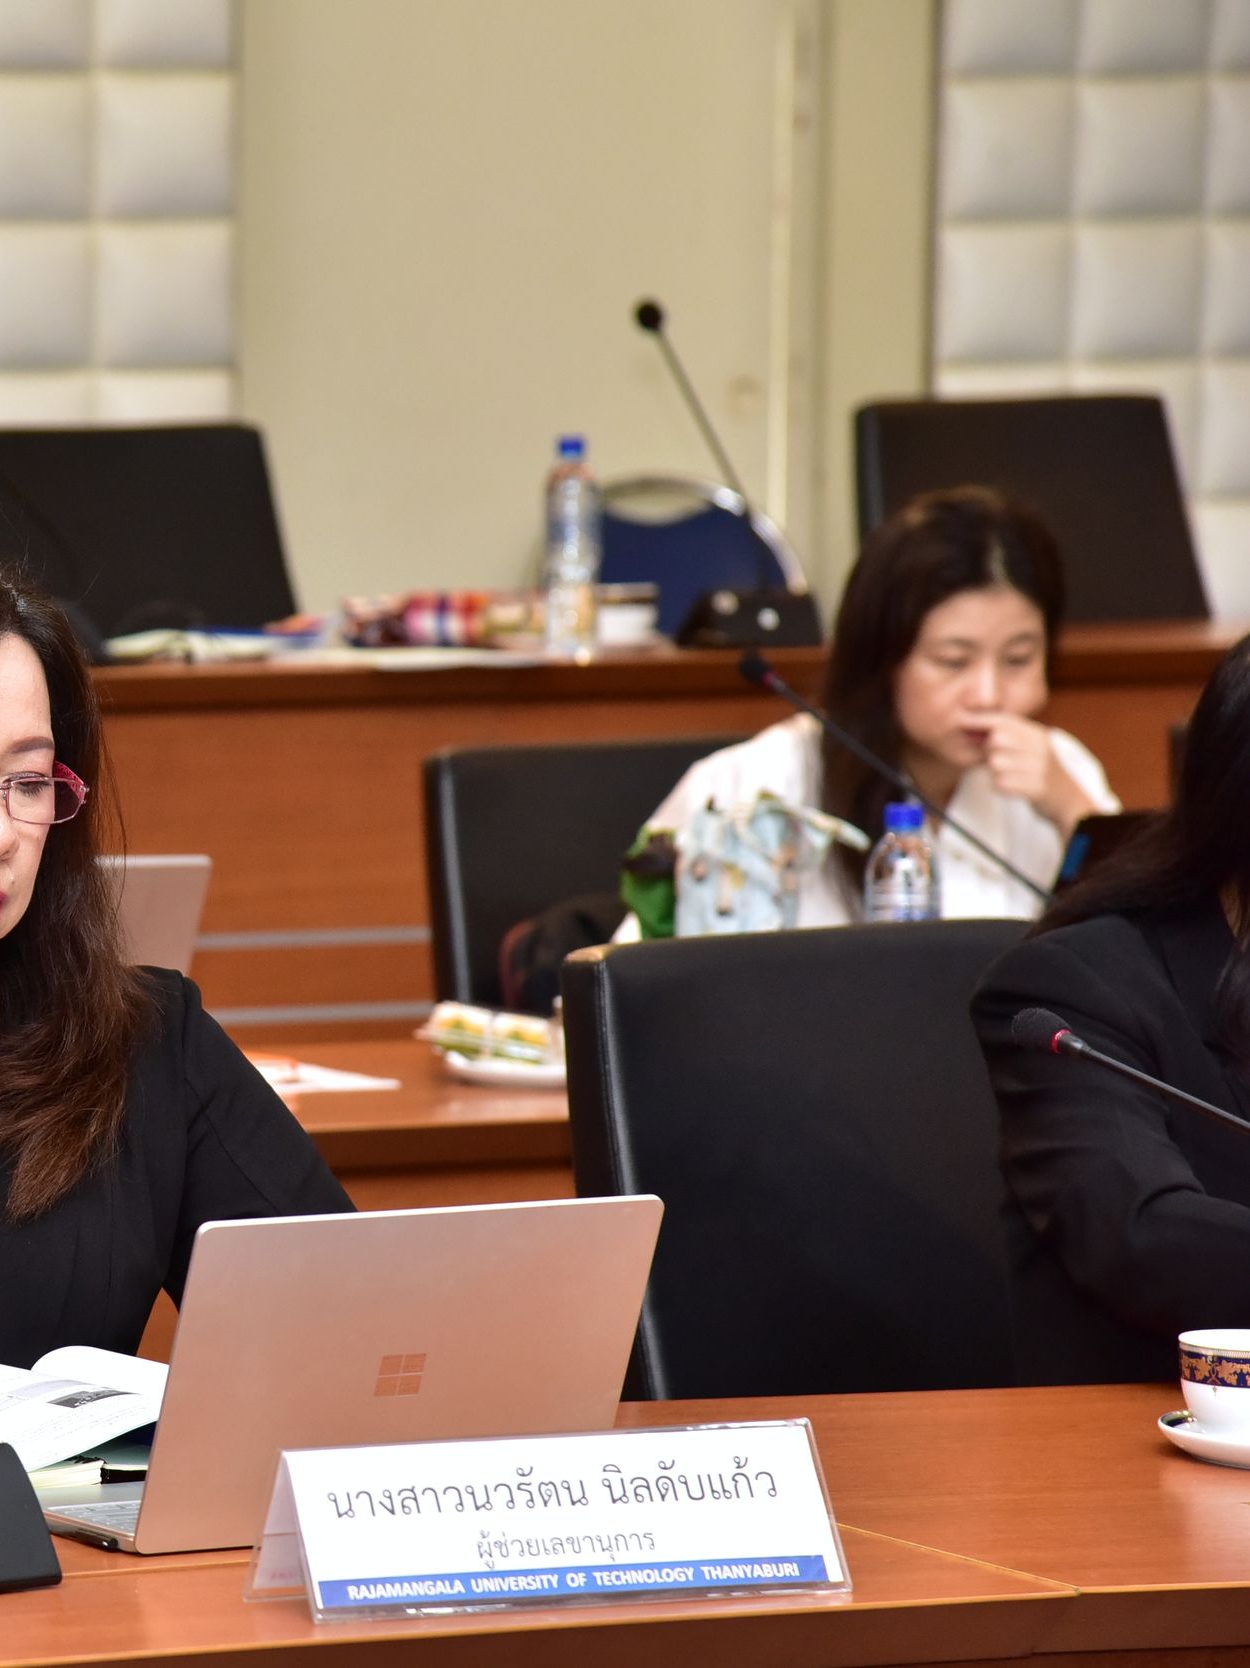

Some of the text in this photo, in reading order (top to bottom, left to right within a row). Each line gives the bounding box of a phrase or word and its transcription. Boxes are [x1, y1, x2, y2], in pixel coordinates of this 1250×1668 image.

[327, 1455, 778, 1519] นางสาวนวรัตน นิลดับแก้ว
[476, 1529, 656, 1571] ผู้ช่วยเลขานุการ
[346, 1561, 801, 1601] RAJAMANGALA UNIVERSITY OF TECHNOLOGY THANYABURI
